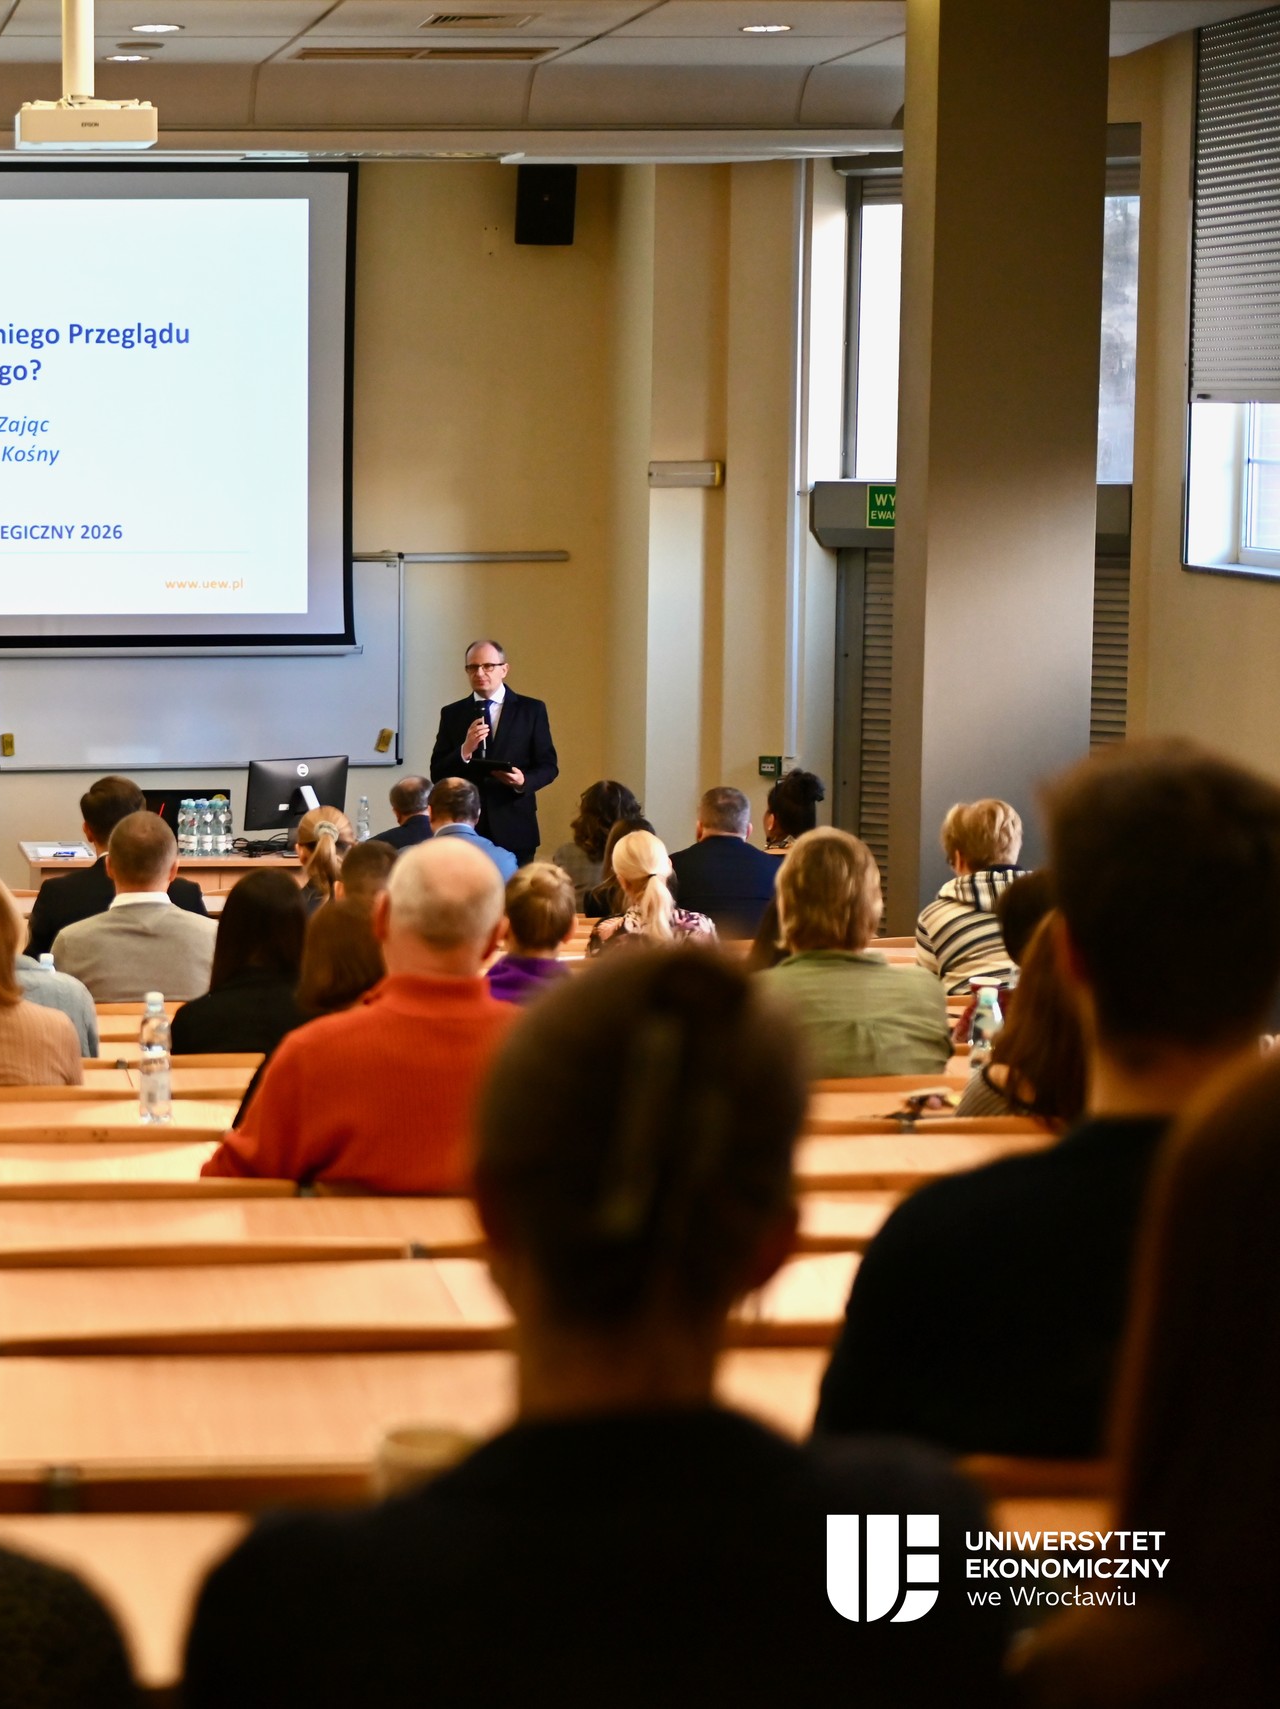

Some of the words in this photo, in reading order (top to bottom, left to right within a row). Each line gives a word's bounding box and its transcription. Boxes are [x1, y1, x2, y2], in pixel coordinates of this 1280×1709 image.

[69, 322, 190, 350] Przeglądu
[1, 444, 60, 466] Kośny
[80, 524, 123, 540] 2026
[164, 578, 244, 591] www.uew.pl
